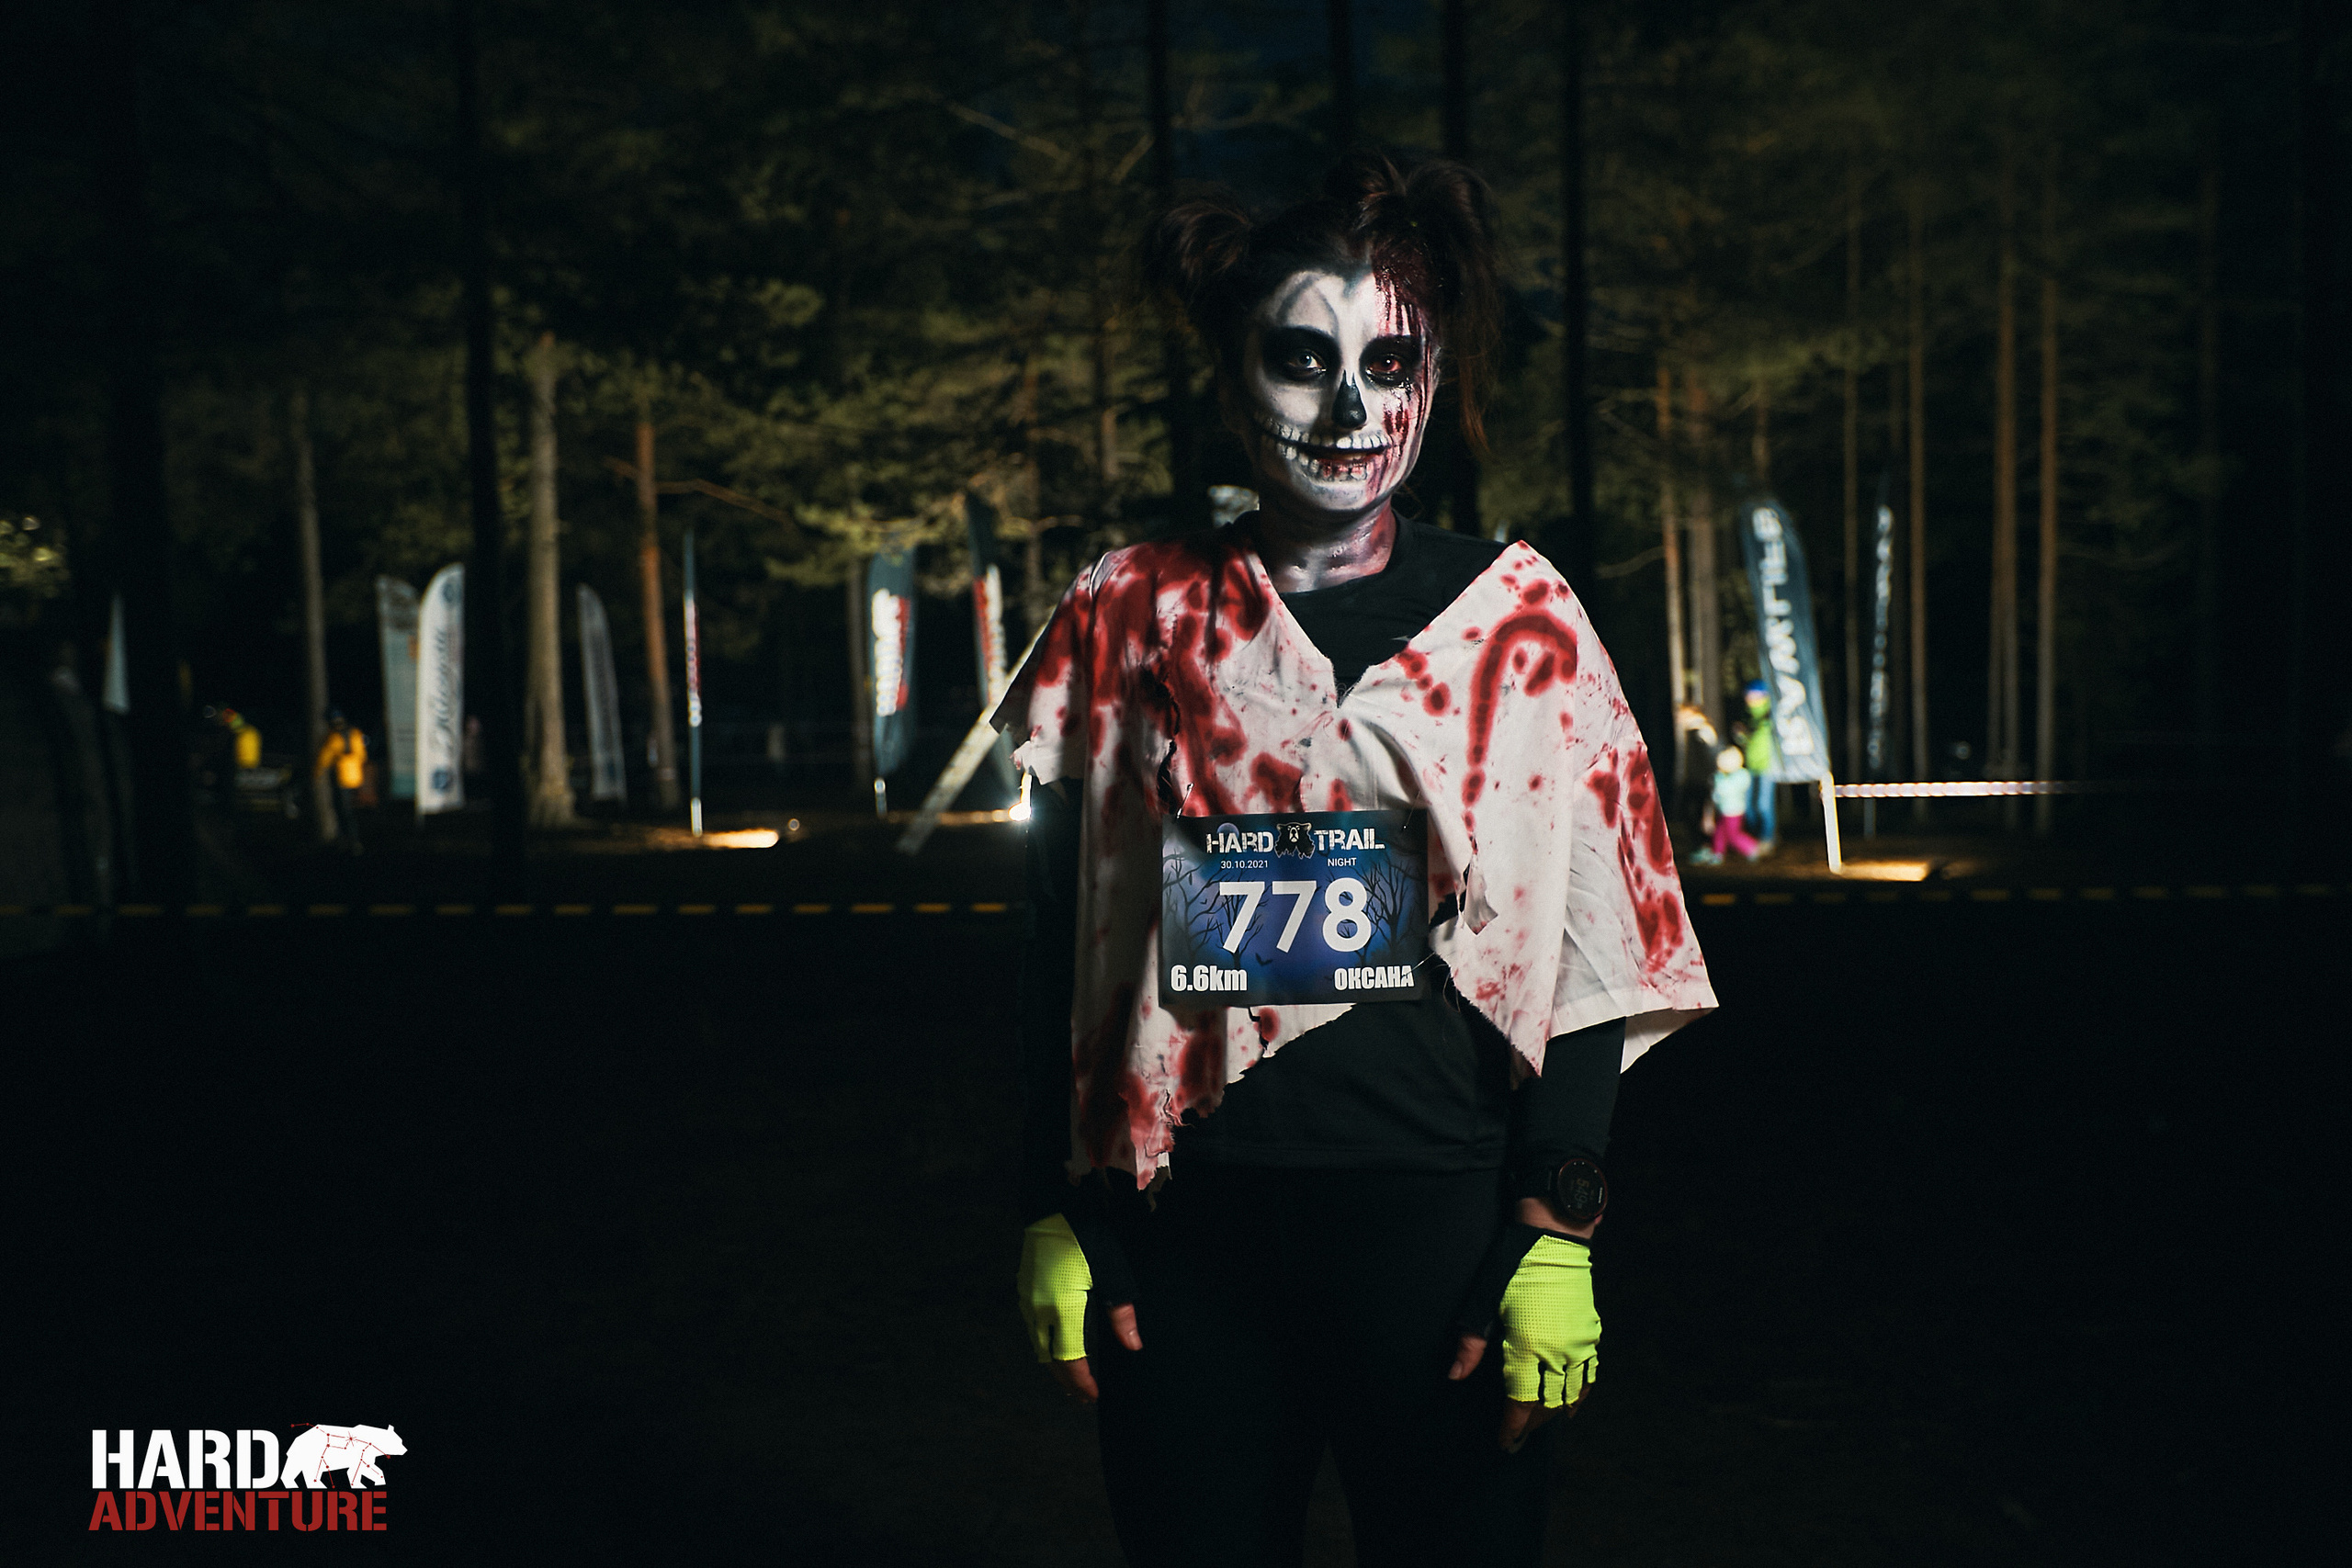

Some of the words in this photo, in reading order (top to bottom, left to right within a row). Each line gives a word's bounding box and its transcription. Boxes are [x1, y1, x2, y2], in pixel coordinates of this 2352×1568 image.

[1205, 831, 1273, 853] HARD
[1314, 828, 1385, 852] TRAIL
[1220, 859, 1269, 870] 30.10.2021
[1327, 857, 1357, 868] NIGHT
[1218, 876, 1372, 954] 778
[1170, 964, 1248, 992] 6.6km
[1333, 964, 1415, 991] ОКСАНА
